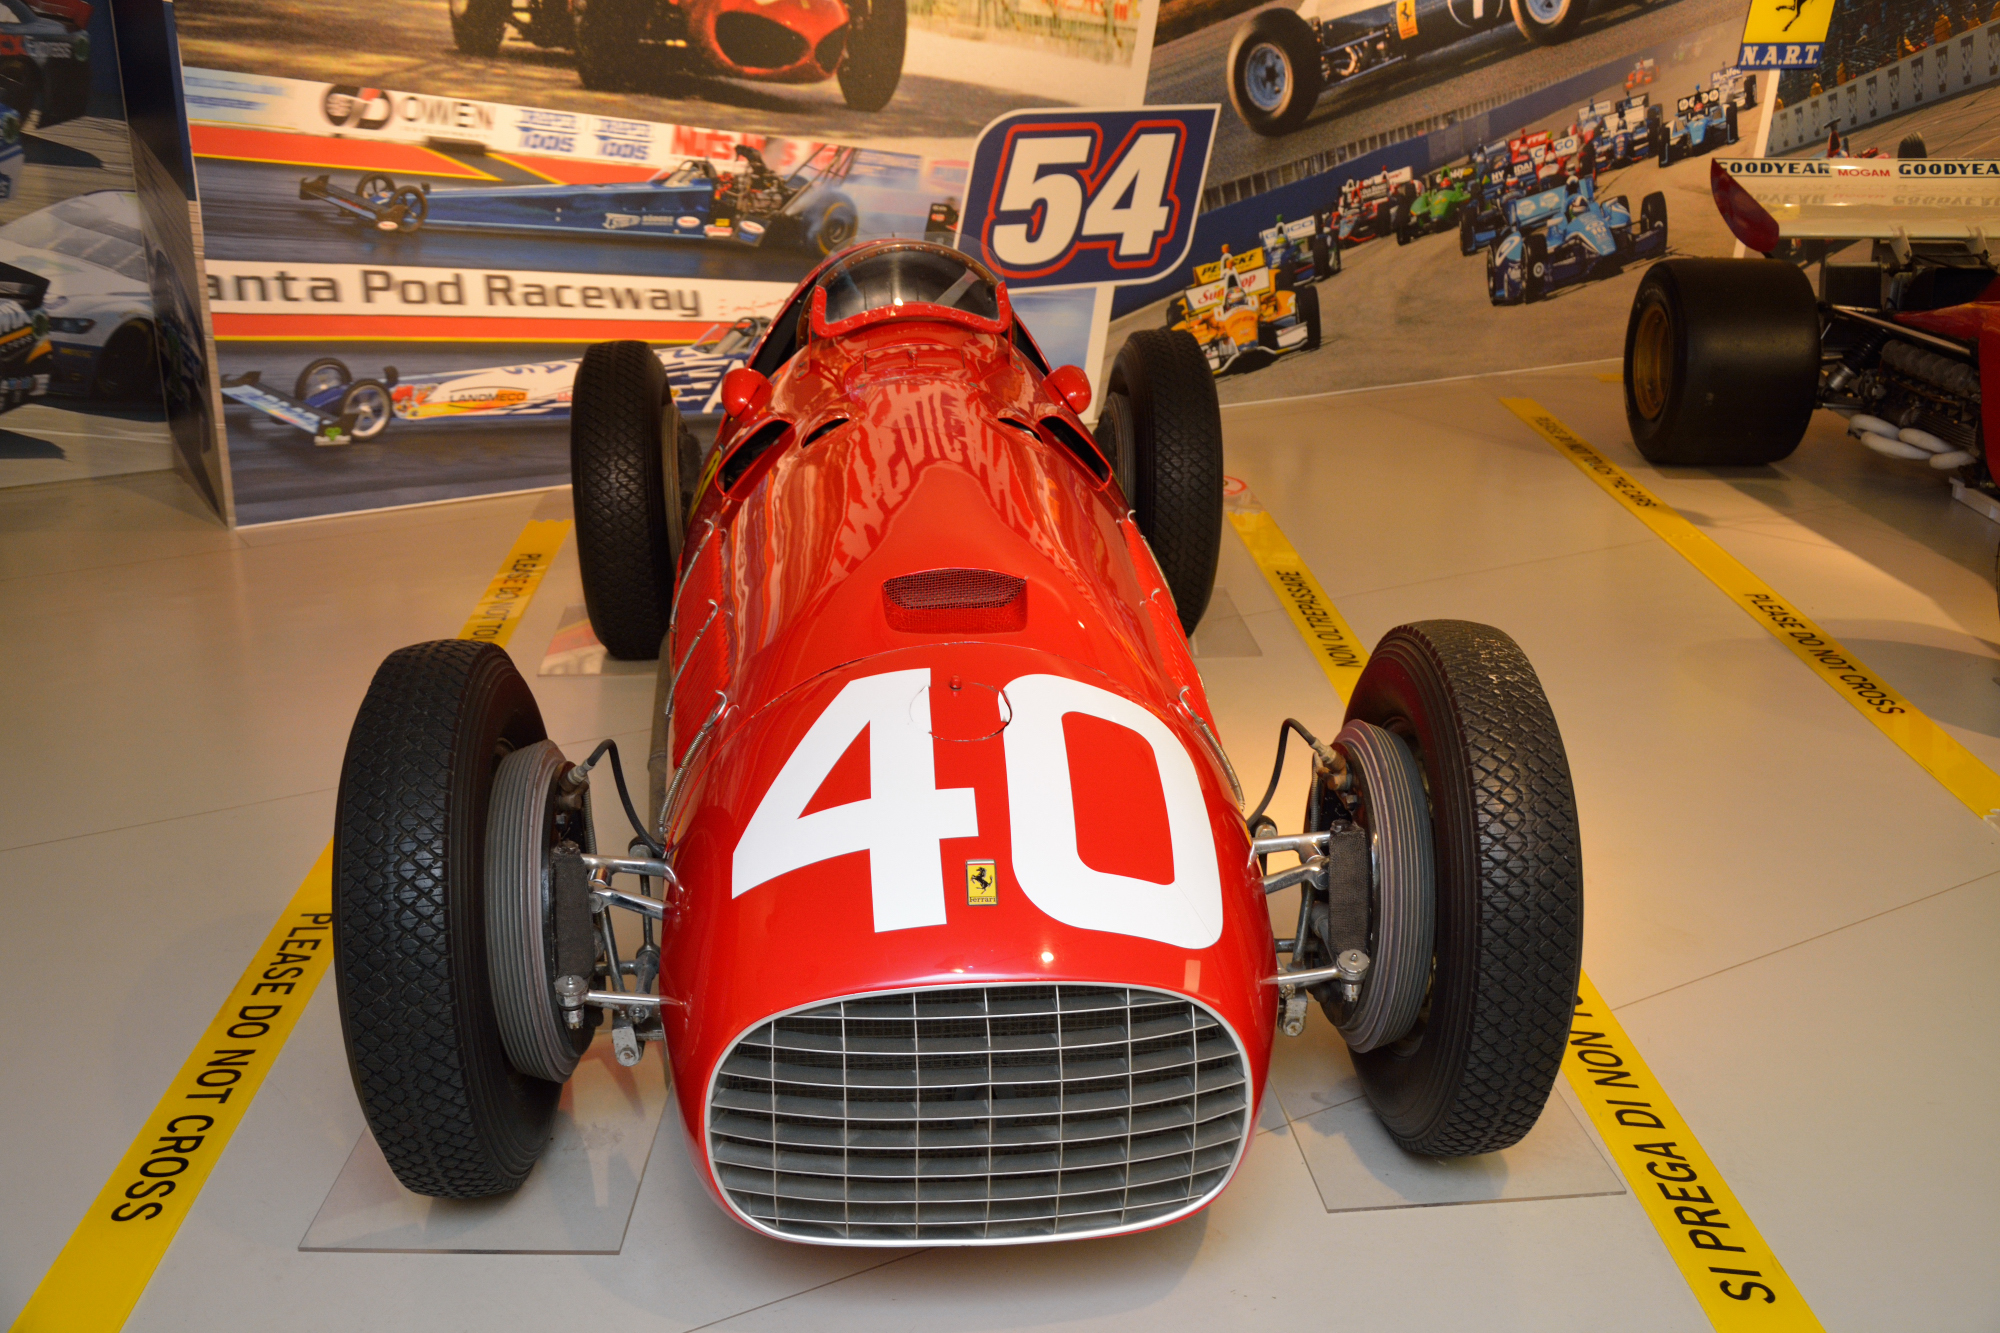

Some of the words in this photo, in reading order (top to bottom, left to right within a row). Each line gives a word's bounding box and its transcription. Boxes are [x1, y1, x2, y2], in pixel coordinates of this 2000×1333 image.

[1740, 45, 1820, 66] N.A.R.T.
[400, 96, 496, 130] OWEN
[1838, 168, 1890, 177] MOGAM
[993, 133, 1176, 265] 54
[1265, 219, 1314, 240] GICO
[361, 269, 465, 305] Pod
[483, 274, 701, 318] Raceway
[502, 553, 542, 584] PLEASE
[495, 586, 523, 600] DO
[1275, 569, 1344, 641] OLTREPASSARE
[1322, 643, 1363, 668] NON
[1744, 593, 1806, 629] PLEASE
[1788, 632, 1825, 647] DO
[1809, 649, 1857, 671] NOT
[1839, 674, 1906, 714] CROSS
[732, 668, 1223, 949] 40
[251, 912, 332, 996] PLEASE
[226, 1005, 283, 1039] DO
[185, 1049, 257, 1104] NOT
[1569, 1030, 1641, 1089] NON
[1605, 1099, 1667, 1130] DI
[110, 1114, 215, 1222] CROSS
[1632, 1141, 1747, 1253] PREGA
[1707, 1266, 1776, 1304] SI
